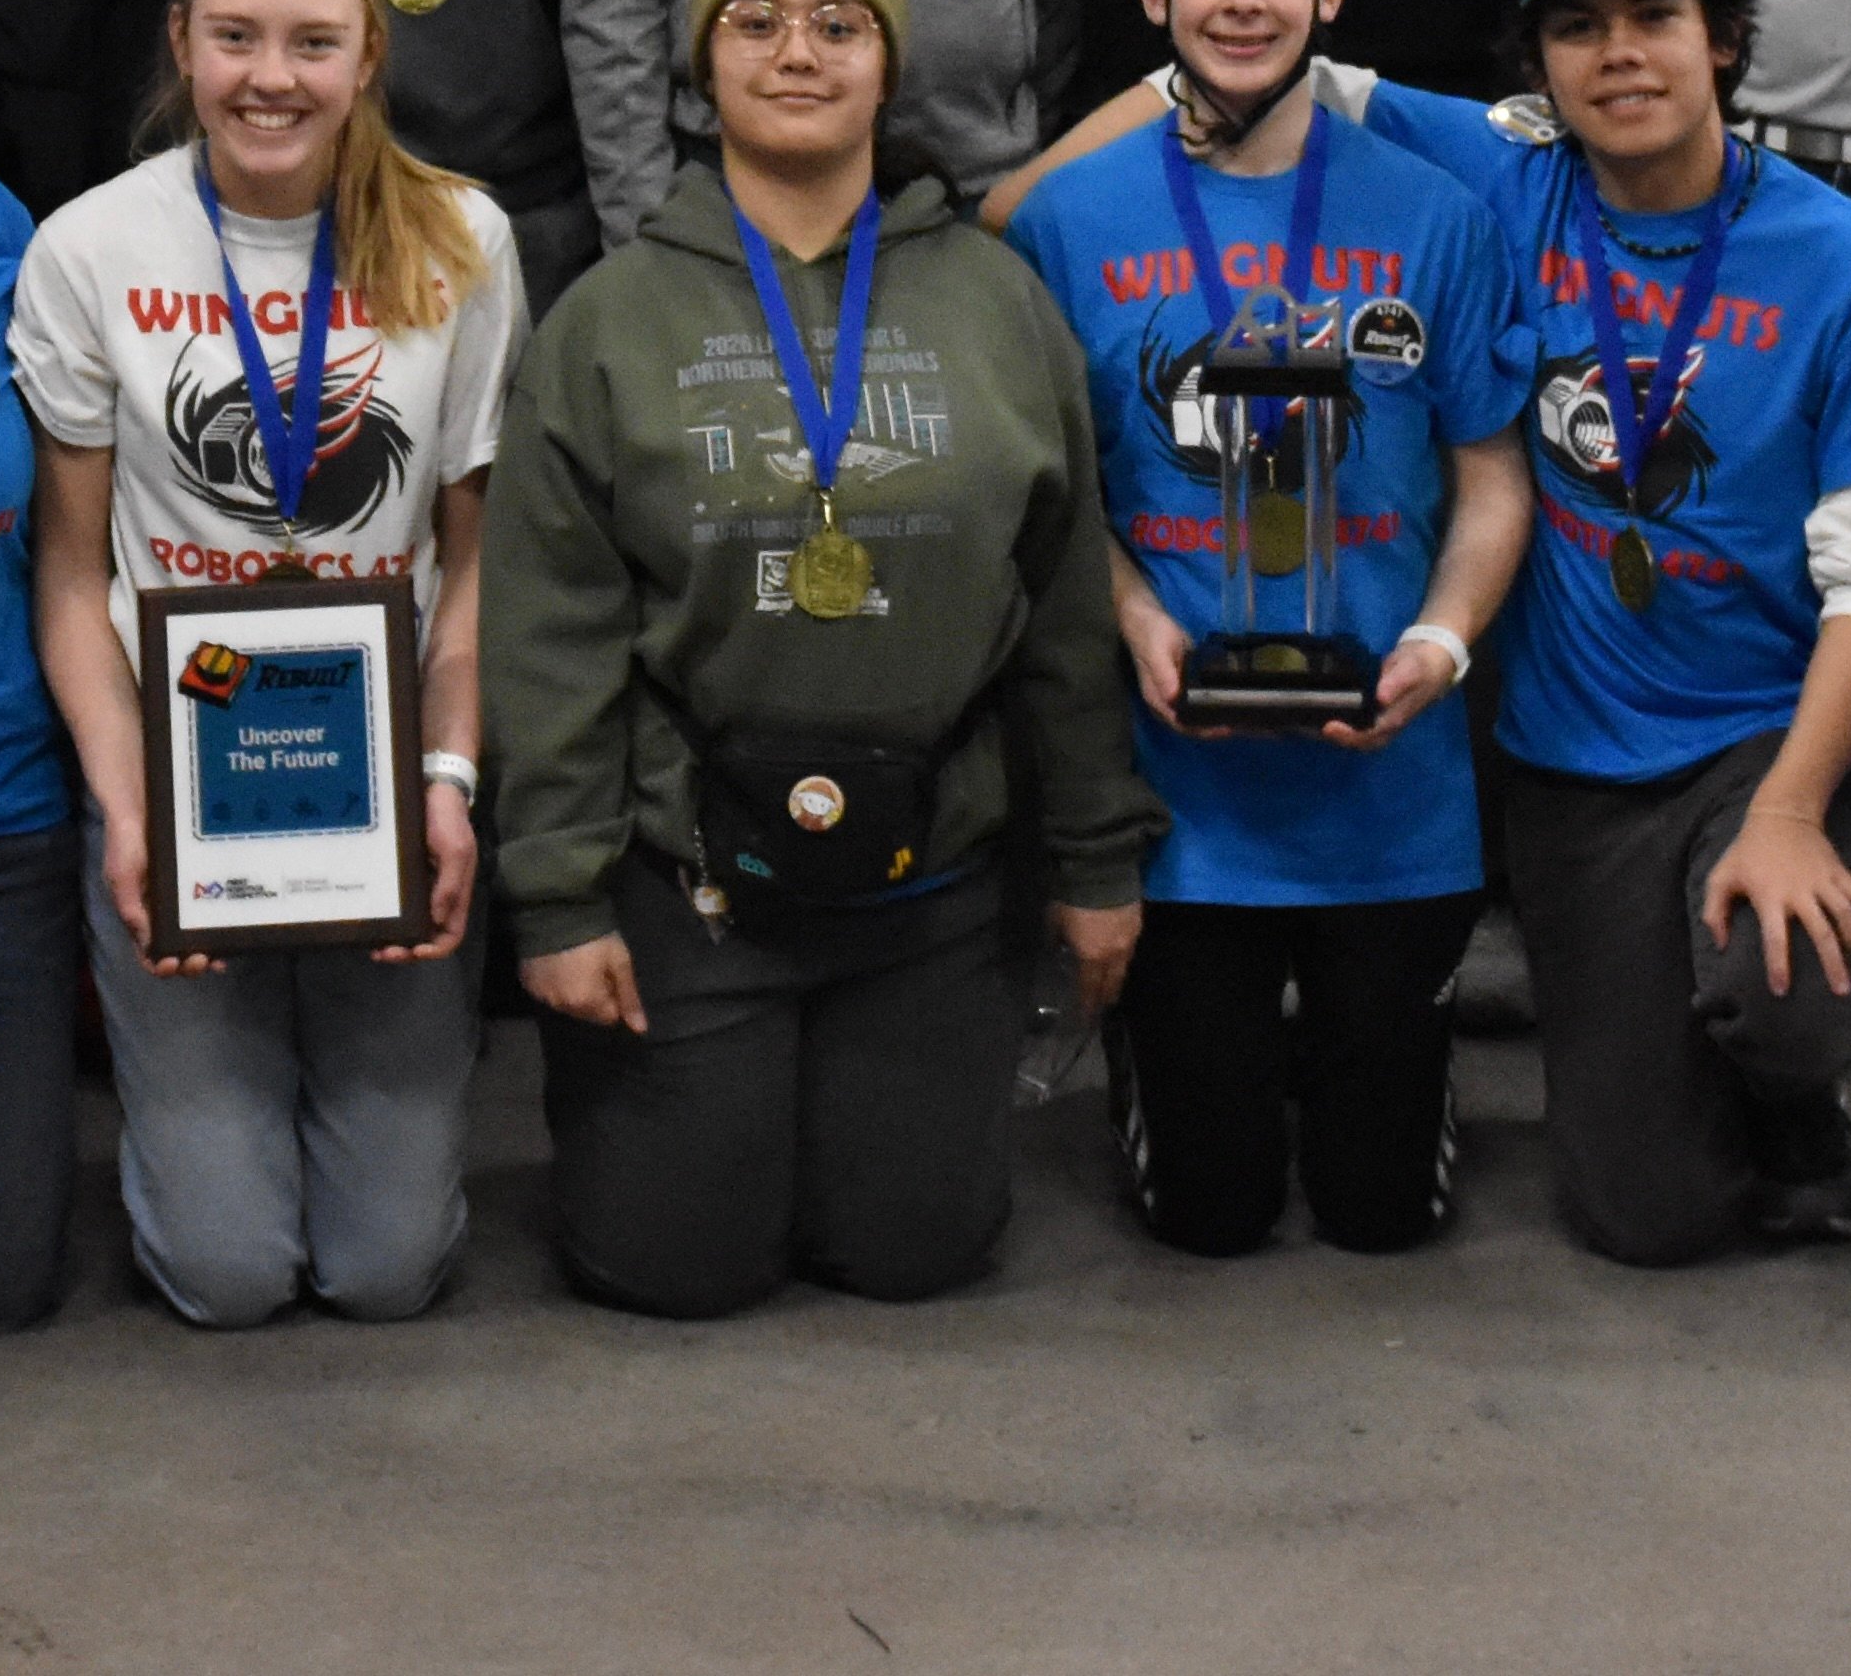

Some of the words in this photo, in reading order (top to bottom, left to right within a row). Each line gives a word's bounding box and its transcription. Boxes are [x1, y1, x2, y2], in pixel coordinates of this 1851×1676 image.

[238, 726, 325, 745] Uncover
[226, 751, 266, 770] The
[271, 749, 340, 769] Future
